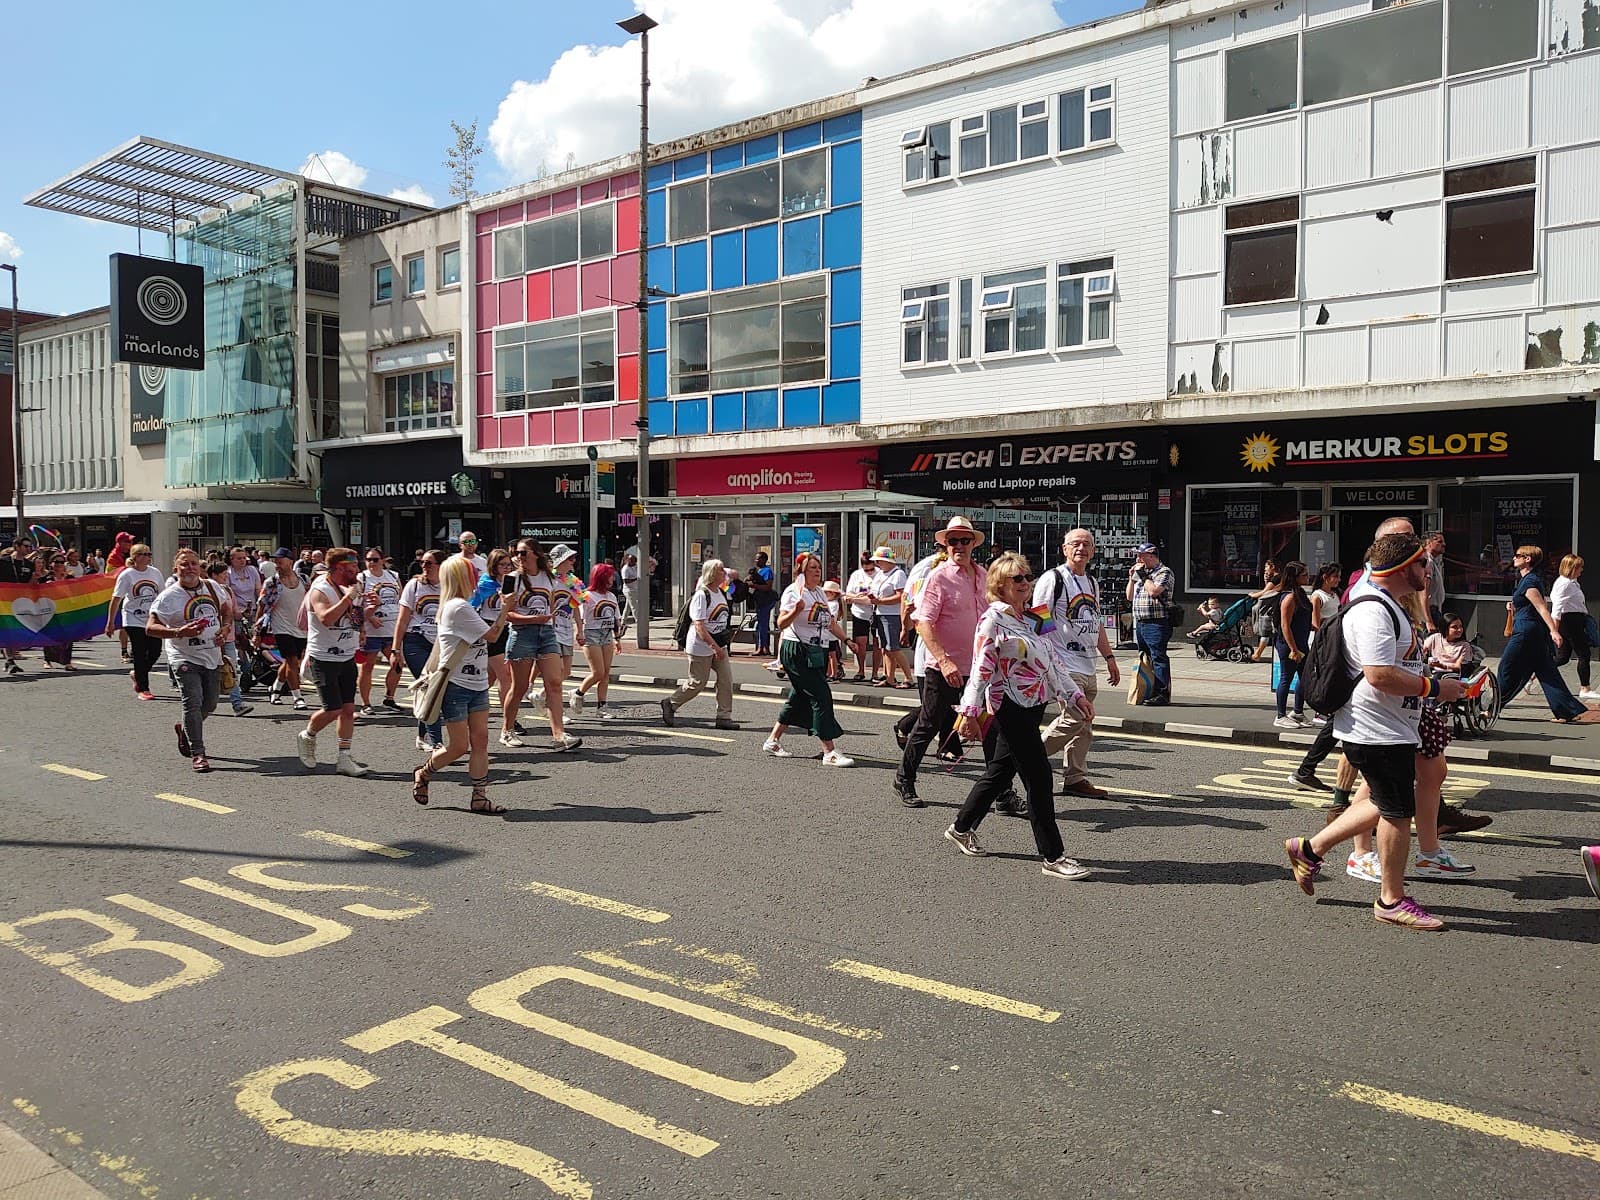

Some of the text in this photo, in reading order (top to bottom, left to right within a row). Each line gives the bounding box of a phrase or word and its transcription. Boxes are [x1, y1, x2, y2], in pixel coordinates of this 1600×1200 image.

[124, 341, 200, 359] marlands
[934, 440, 1138, 470] TECH EXPERTS
[1285, 431, 1509, 461] MERKUR SLOTS
[727, 468, 792, 491] amplifon
[943, 474, 1077, 492] Mobile and Laptop repairs
[345, 480, 447, 499] STARBUCKS COFFEE
[1346, 490, 1417, 502] WELCOME
[1224, 504, 1259, 512] MATCH
[1497, 500, 1542, 509] MATCH
[1502, 508, 1539, 516] PLAYS
[1227, 511, 1256, 519] PLAYS
[544, 528, 560, 537] Done
[0, 860, 430, 1003] BUS
[234, 937, 883, 1199] STOP
